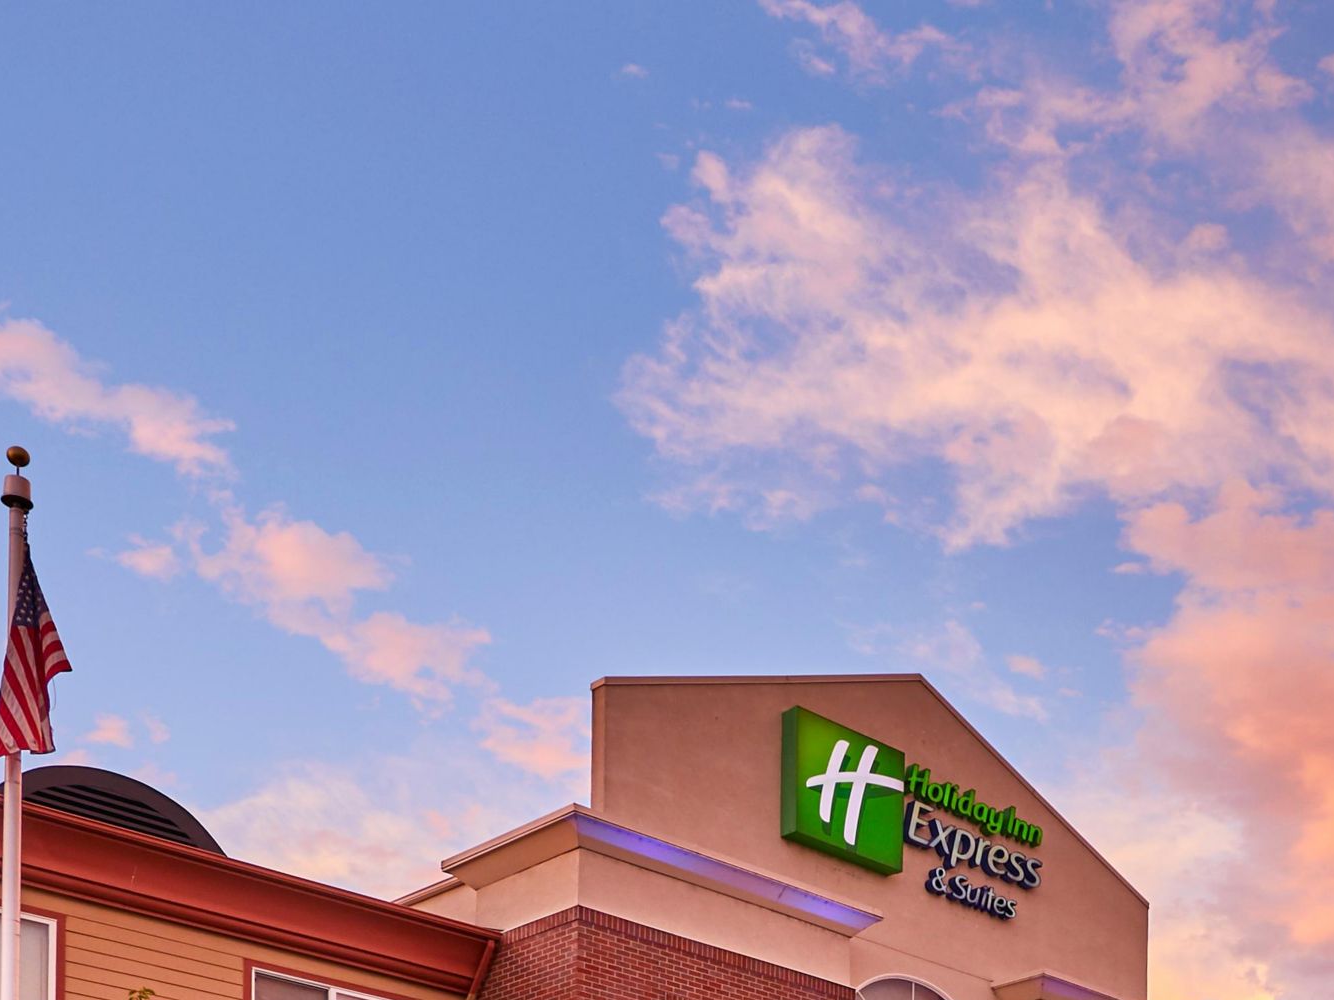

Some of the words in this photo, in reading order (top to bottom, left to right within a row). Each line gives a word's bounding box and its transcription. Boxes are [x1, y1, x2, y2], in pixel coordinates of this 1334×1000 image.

[907, 764, 1005, 835] Holiday
[1007, 806, 1044, 847] Inn
[907, 800, 1043, 889] Express
[931, 867, 948, 893] &
[952, 875, 1018, 920] Suites
